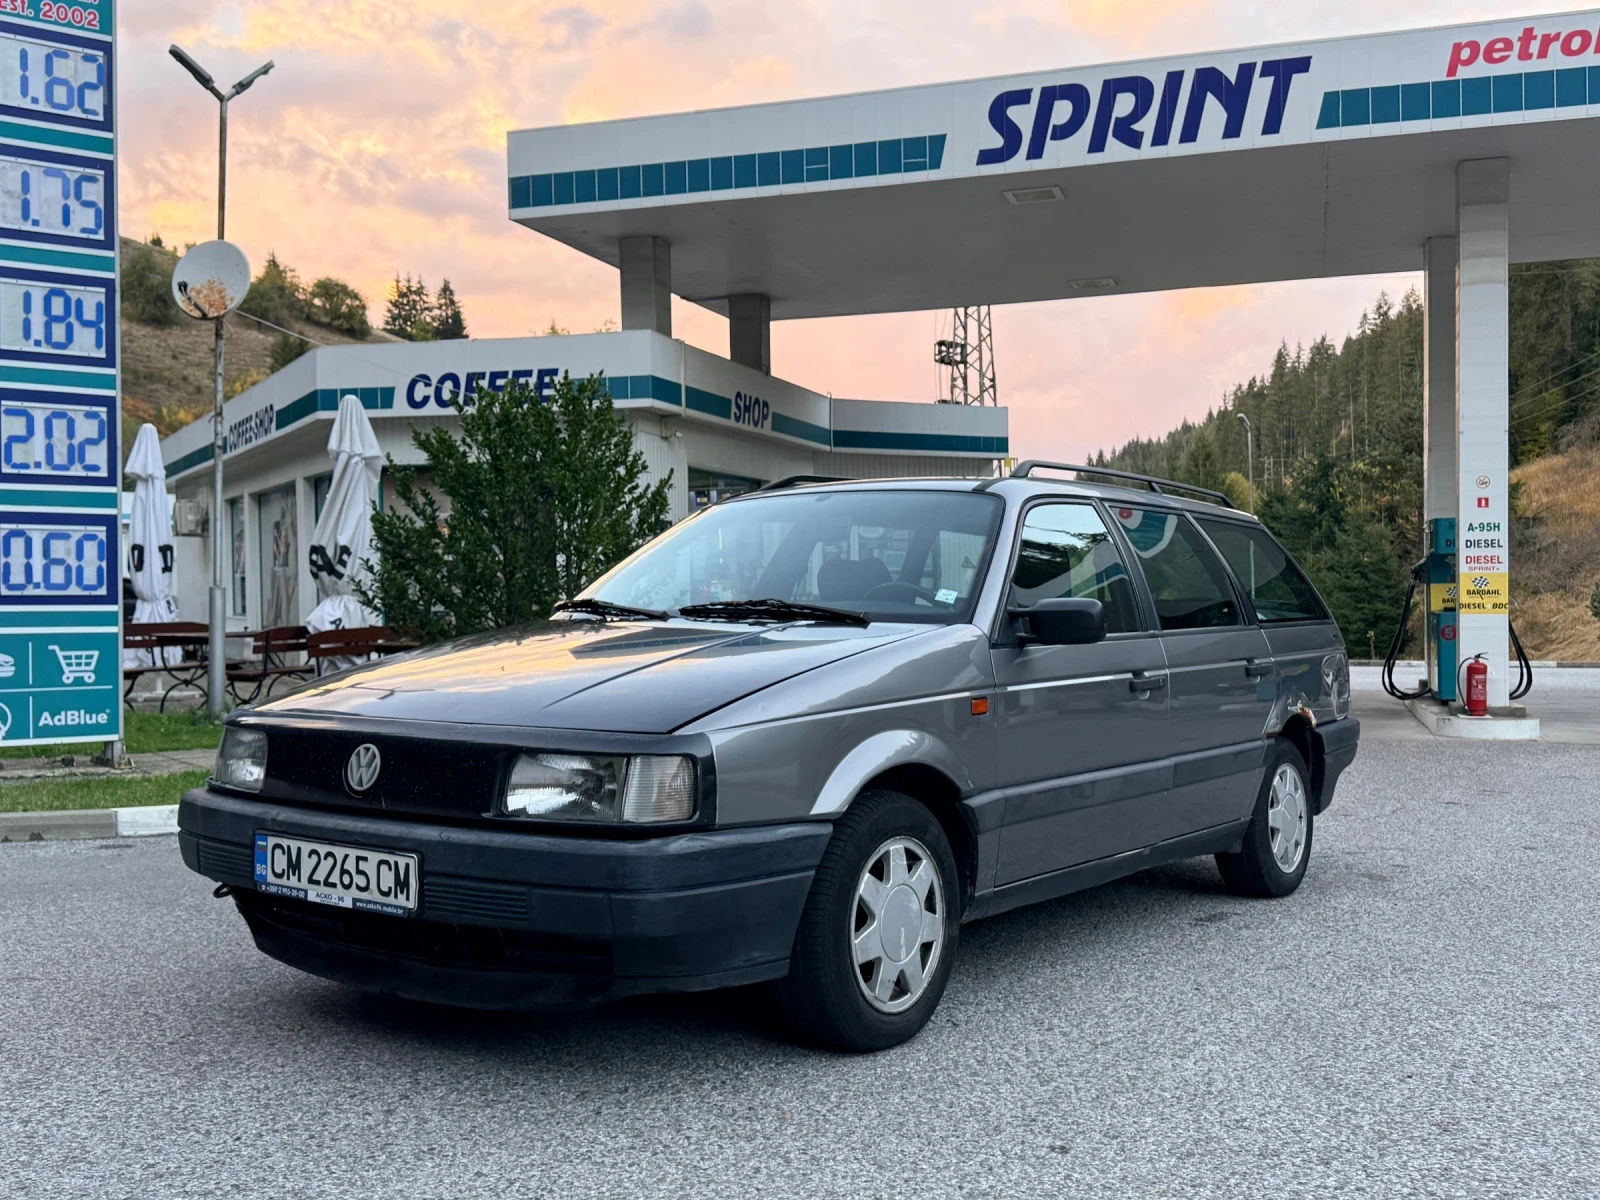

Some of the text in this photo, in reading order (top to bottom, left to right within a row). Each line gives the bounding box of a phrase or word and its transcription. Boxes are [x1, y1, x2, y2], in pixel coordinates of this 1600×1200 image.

[40, 1, 99, 30] 2002
[19, 47, 104, 117] 1.62
[975, 55, 1313, 167] SPRINT
[21, 169, 103, 235] 1.75
[23, 288, 104, 350] 1.84
[733, 390, 770, 429] SHOP
[3, 408, 106, 472] 2.02
[2, 529, 105, 592] 0.60
[1465, 539, 1503, 548] DIESEL
[1465, 555, 1503, 564] DIESEL
[1459, 602, 1486, 610] DIESEL
[38, 708, 108, 727] AdBlue
[256, 863, 267, 875] BG
[270, 842, 411, 902] CM 2265 CM
